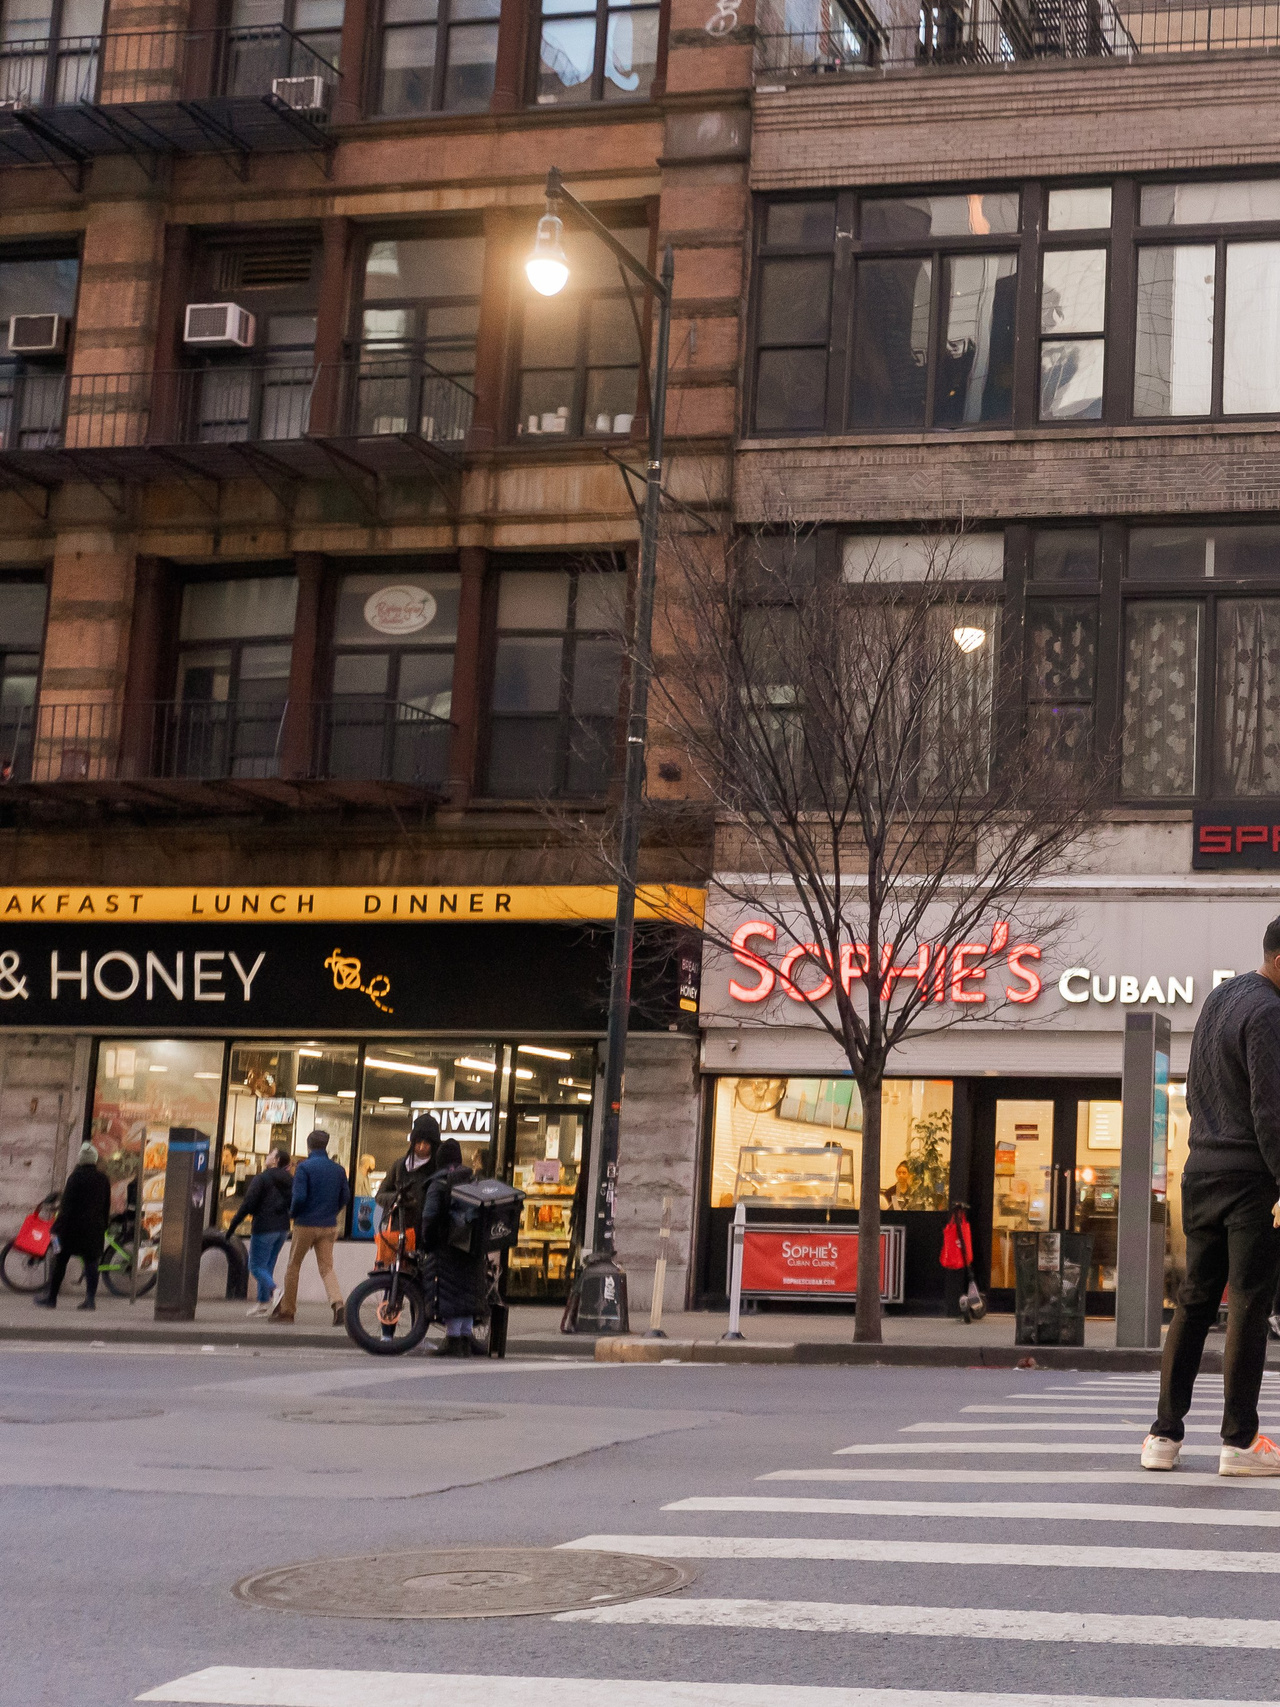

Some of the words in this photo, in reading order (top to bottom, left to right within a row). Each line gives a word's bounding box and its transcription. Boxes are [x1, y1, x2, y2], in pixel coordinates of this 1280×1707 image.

[4, 893, 144, 915] AKFAST
[191, 893, 315, 915] LUNCH
[363, 892, 513, 915] DINNER
[0, 949, 30, 1001] &
[50, 949, 267, 1002] HONEY
[728, 919, 1042, 1004] SOPHIE'S
[1058, 966, 1195, 1005] CUBAN
[782, 1241, 838, 1259] SOPHIE'S
[787, 1258, 810, 1267] CUBAN
